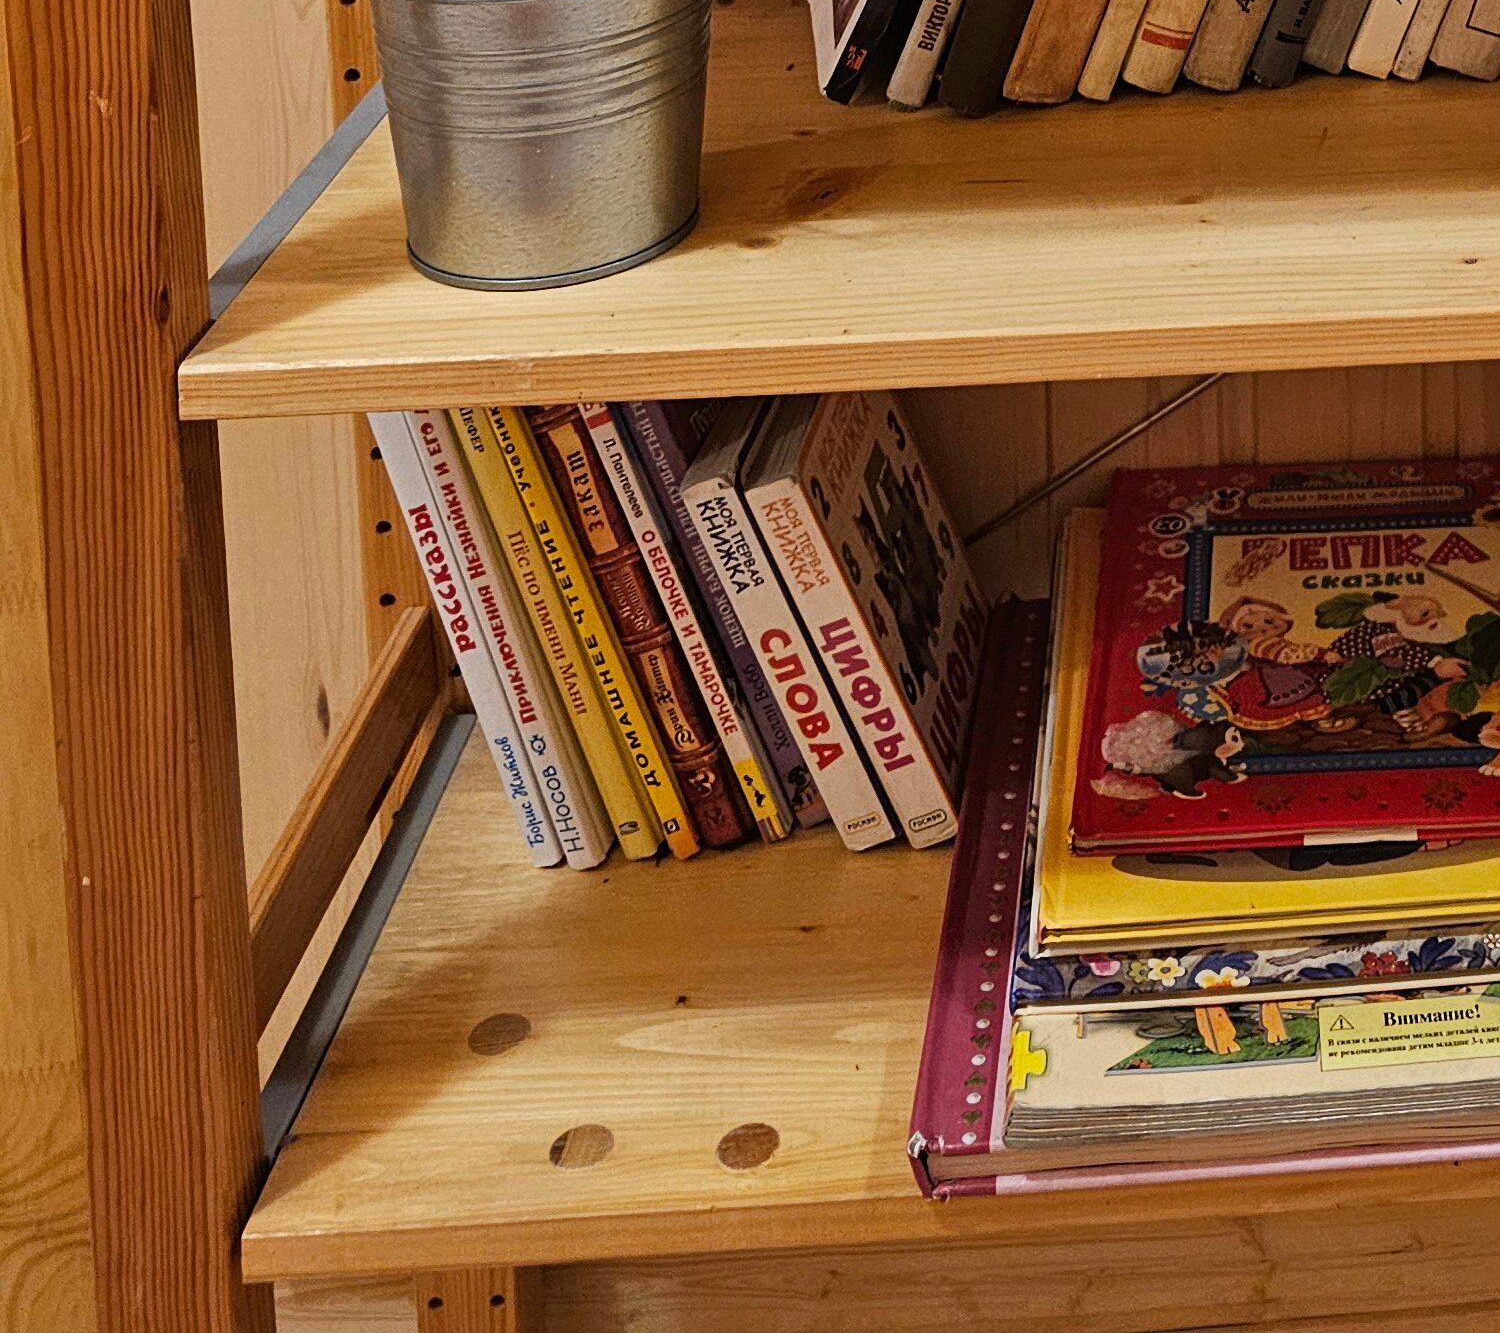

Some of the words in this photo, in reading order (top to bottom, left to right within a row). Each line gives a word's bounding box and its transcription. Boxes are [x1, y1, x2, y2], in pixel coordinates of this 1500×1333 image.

[607, 452, 646, 520] Пантелеев
[639, 527, 658, 545] О
[693, 498, 753, 594] КНИЖКА
[712, 493, 738, 530] МОЯ
[729, 530, 766, 587] ПЕРВАЯ
[760, 499, 818, 594] КНИЖКА
[776, 494, 802, 531] МОЯ
[793, 530, 830, 587] ПЕРВАЯ
[1225, 531, 1491, 589] РЕПКА
[405, 503, 479, 654] рассказы
[533, 517, 589, 625] ЧТЕНИЕ
[644, 544, 690, 621] БЕЛОЧКЕ
[680, 623, 697, 638] И
[710, 590, 748, 648] ЩЕНОК
[582, 631, 661, 790] ДОМАШНЕЕ
[686, 640, 740, 736] ТАМАРОЧКЕ
[740, 662, 769, 702] Вебб
[760, 628, 844, 770] СЛОВА
[819, 617, 915, 772] ЦИФРЫ
[756, 699, 791, 751] Холли
[490, 734, 530, 800] Житков
[515, 798, 549, 847] Борис
[1383, 1004, 1481, 1027] Внимание!
[1446, 1026, 1479, 1036] деталей
[1340, 1045, 1406, 1058] рекомендована
